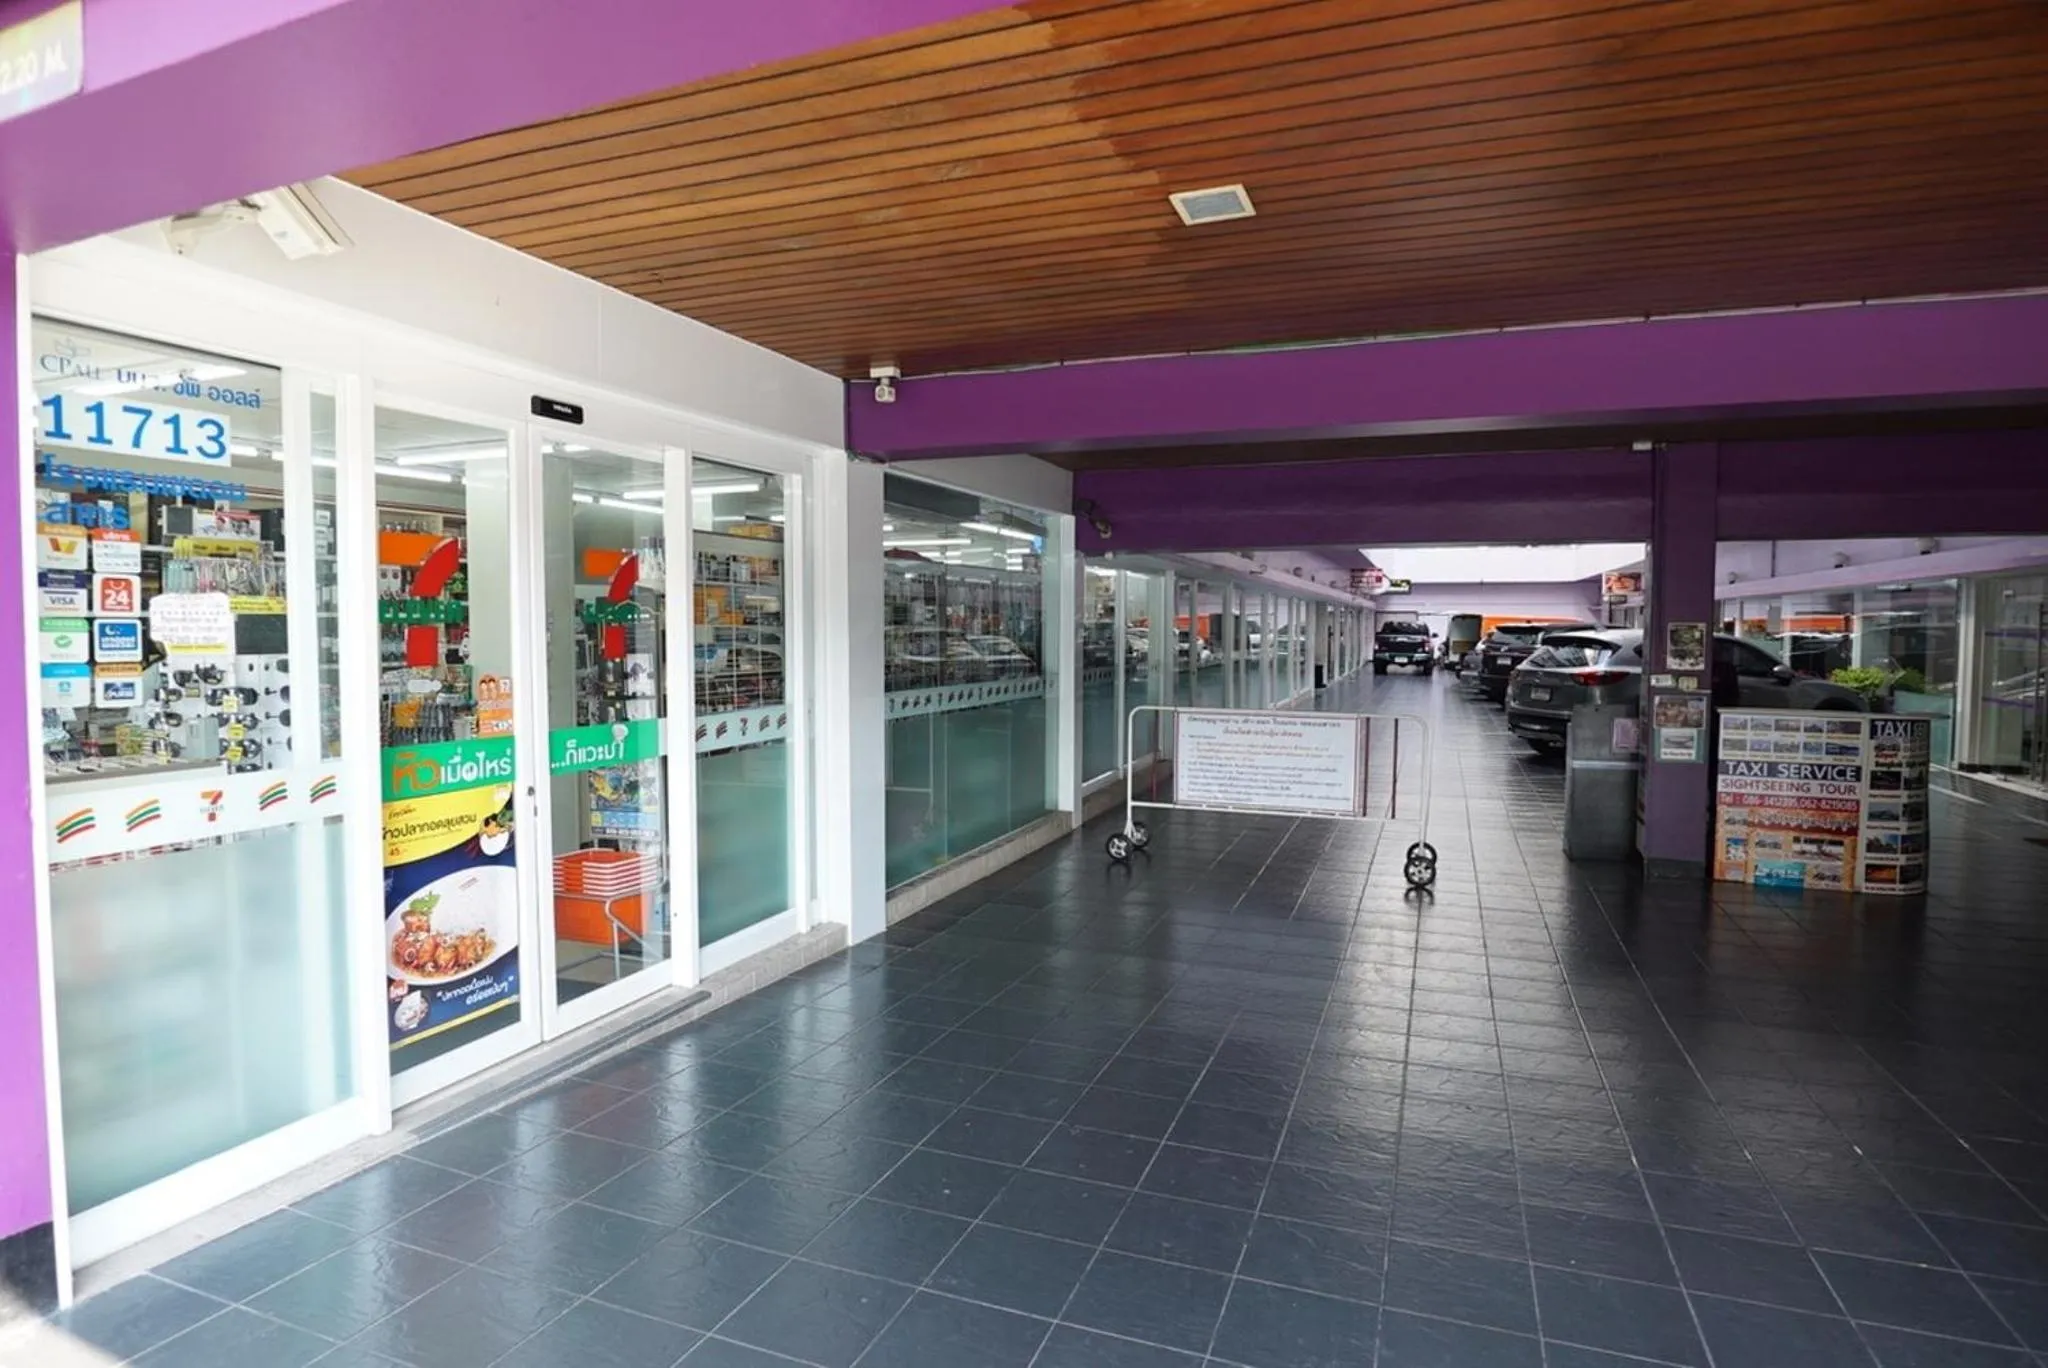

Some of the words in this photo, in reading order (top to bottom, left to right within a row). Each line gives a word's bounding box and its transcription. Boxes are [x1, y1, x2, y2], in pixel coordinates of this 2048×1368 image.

[40, 393, 228, 460] 11713
[49, 597, 76, 605] VISA
[104, 589, 130, 605] 24
[1874, 720, 1911, 738] TAXI
[1725, 761, 1769, 776] TAXI
[1776, 763, 1857, 782] SERVICE
[1721, 777, 1811, 793] SIGHTSEEING
[1818, 783, 1857, 796] TOUR
